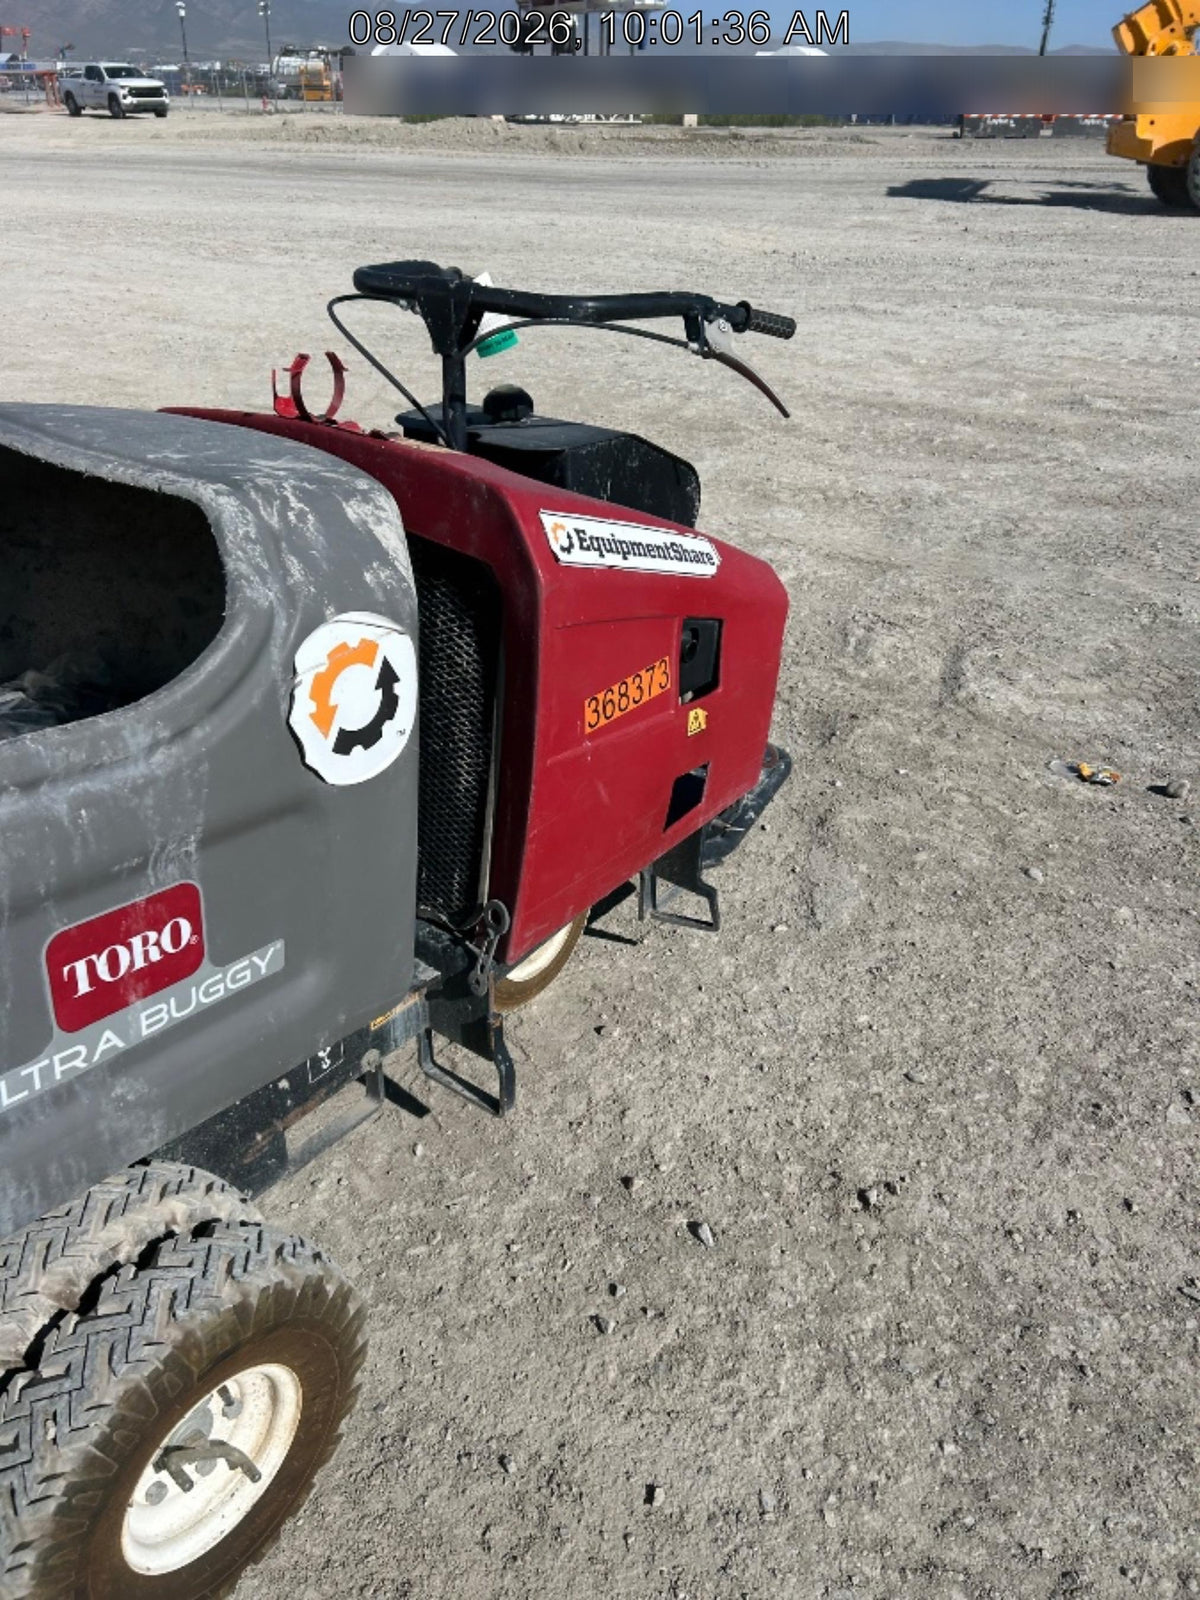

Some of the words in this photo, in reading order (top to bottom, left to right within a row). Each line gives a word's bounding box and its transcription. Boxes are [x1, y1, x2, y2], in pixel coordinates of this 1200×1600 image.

[573, 527, 716, 566] EquipmentShare
[587, 658, 669, 729] 368373
[0, 1029, 126, 1107] LTRA
[139, 946, 275, 1037] BUGGY
